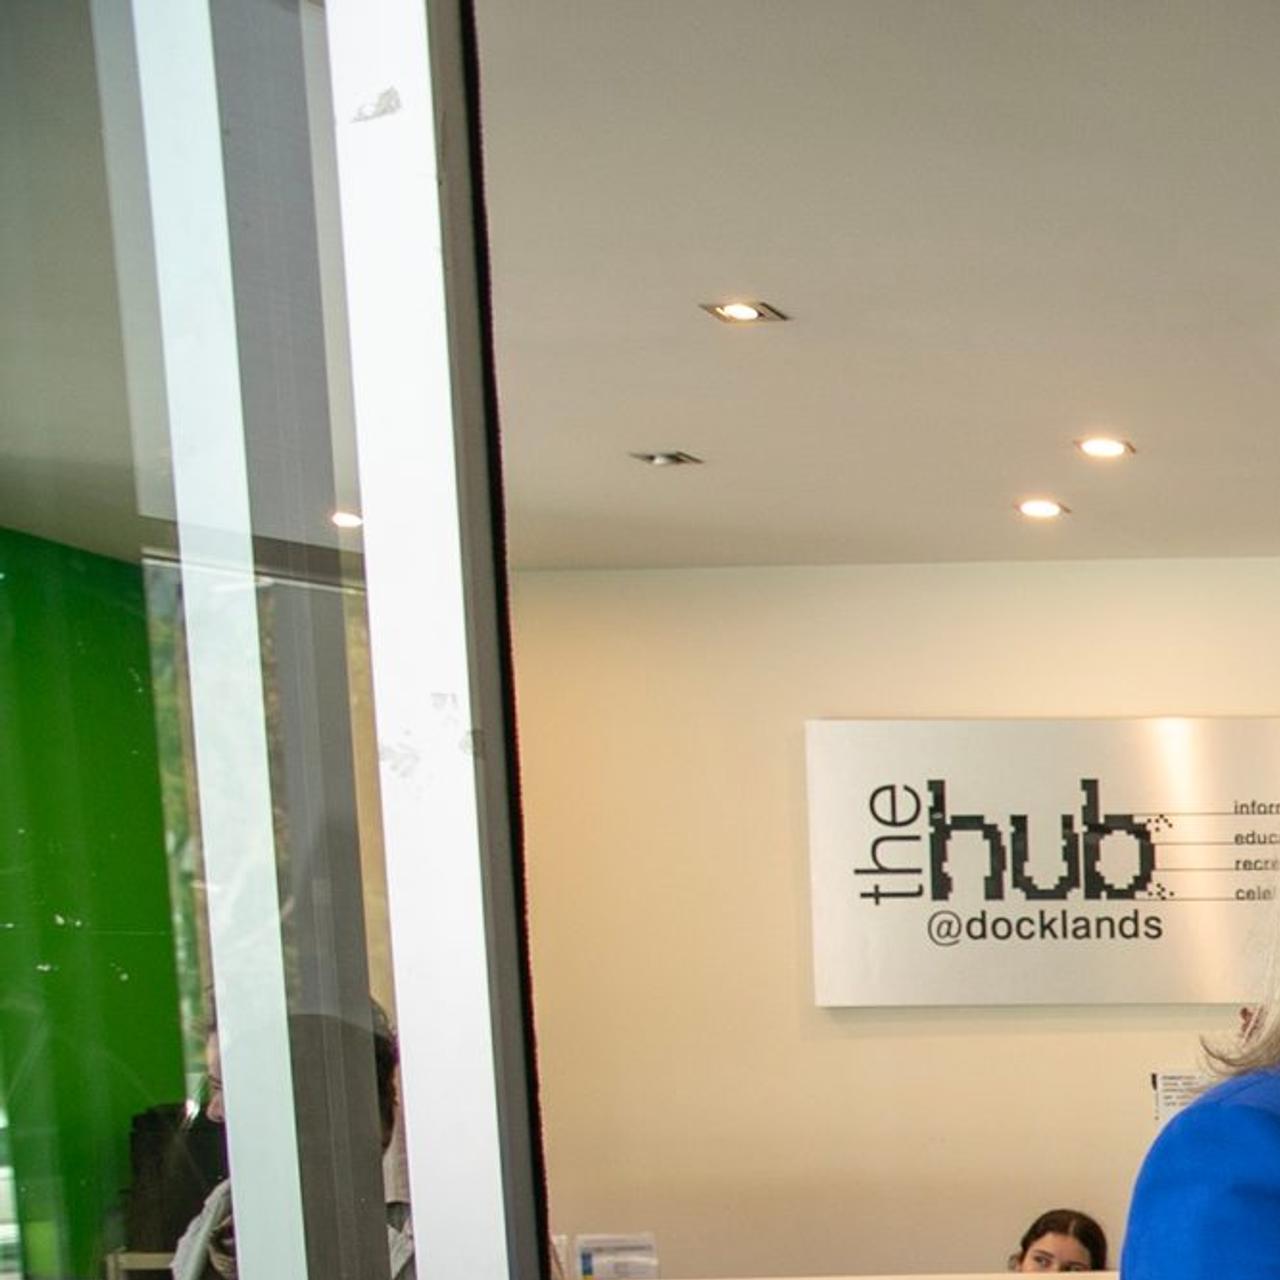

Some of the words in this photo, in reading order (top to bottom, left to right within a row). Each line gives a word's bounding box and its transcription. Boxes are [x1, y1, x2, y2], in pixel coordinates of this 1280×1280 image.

[853, 783, 923, 905] the
[927, 778, 1156, 901] hub
[926, 909, 1164, 947] @docklands
